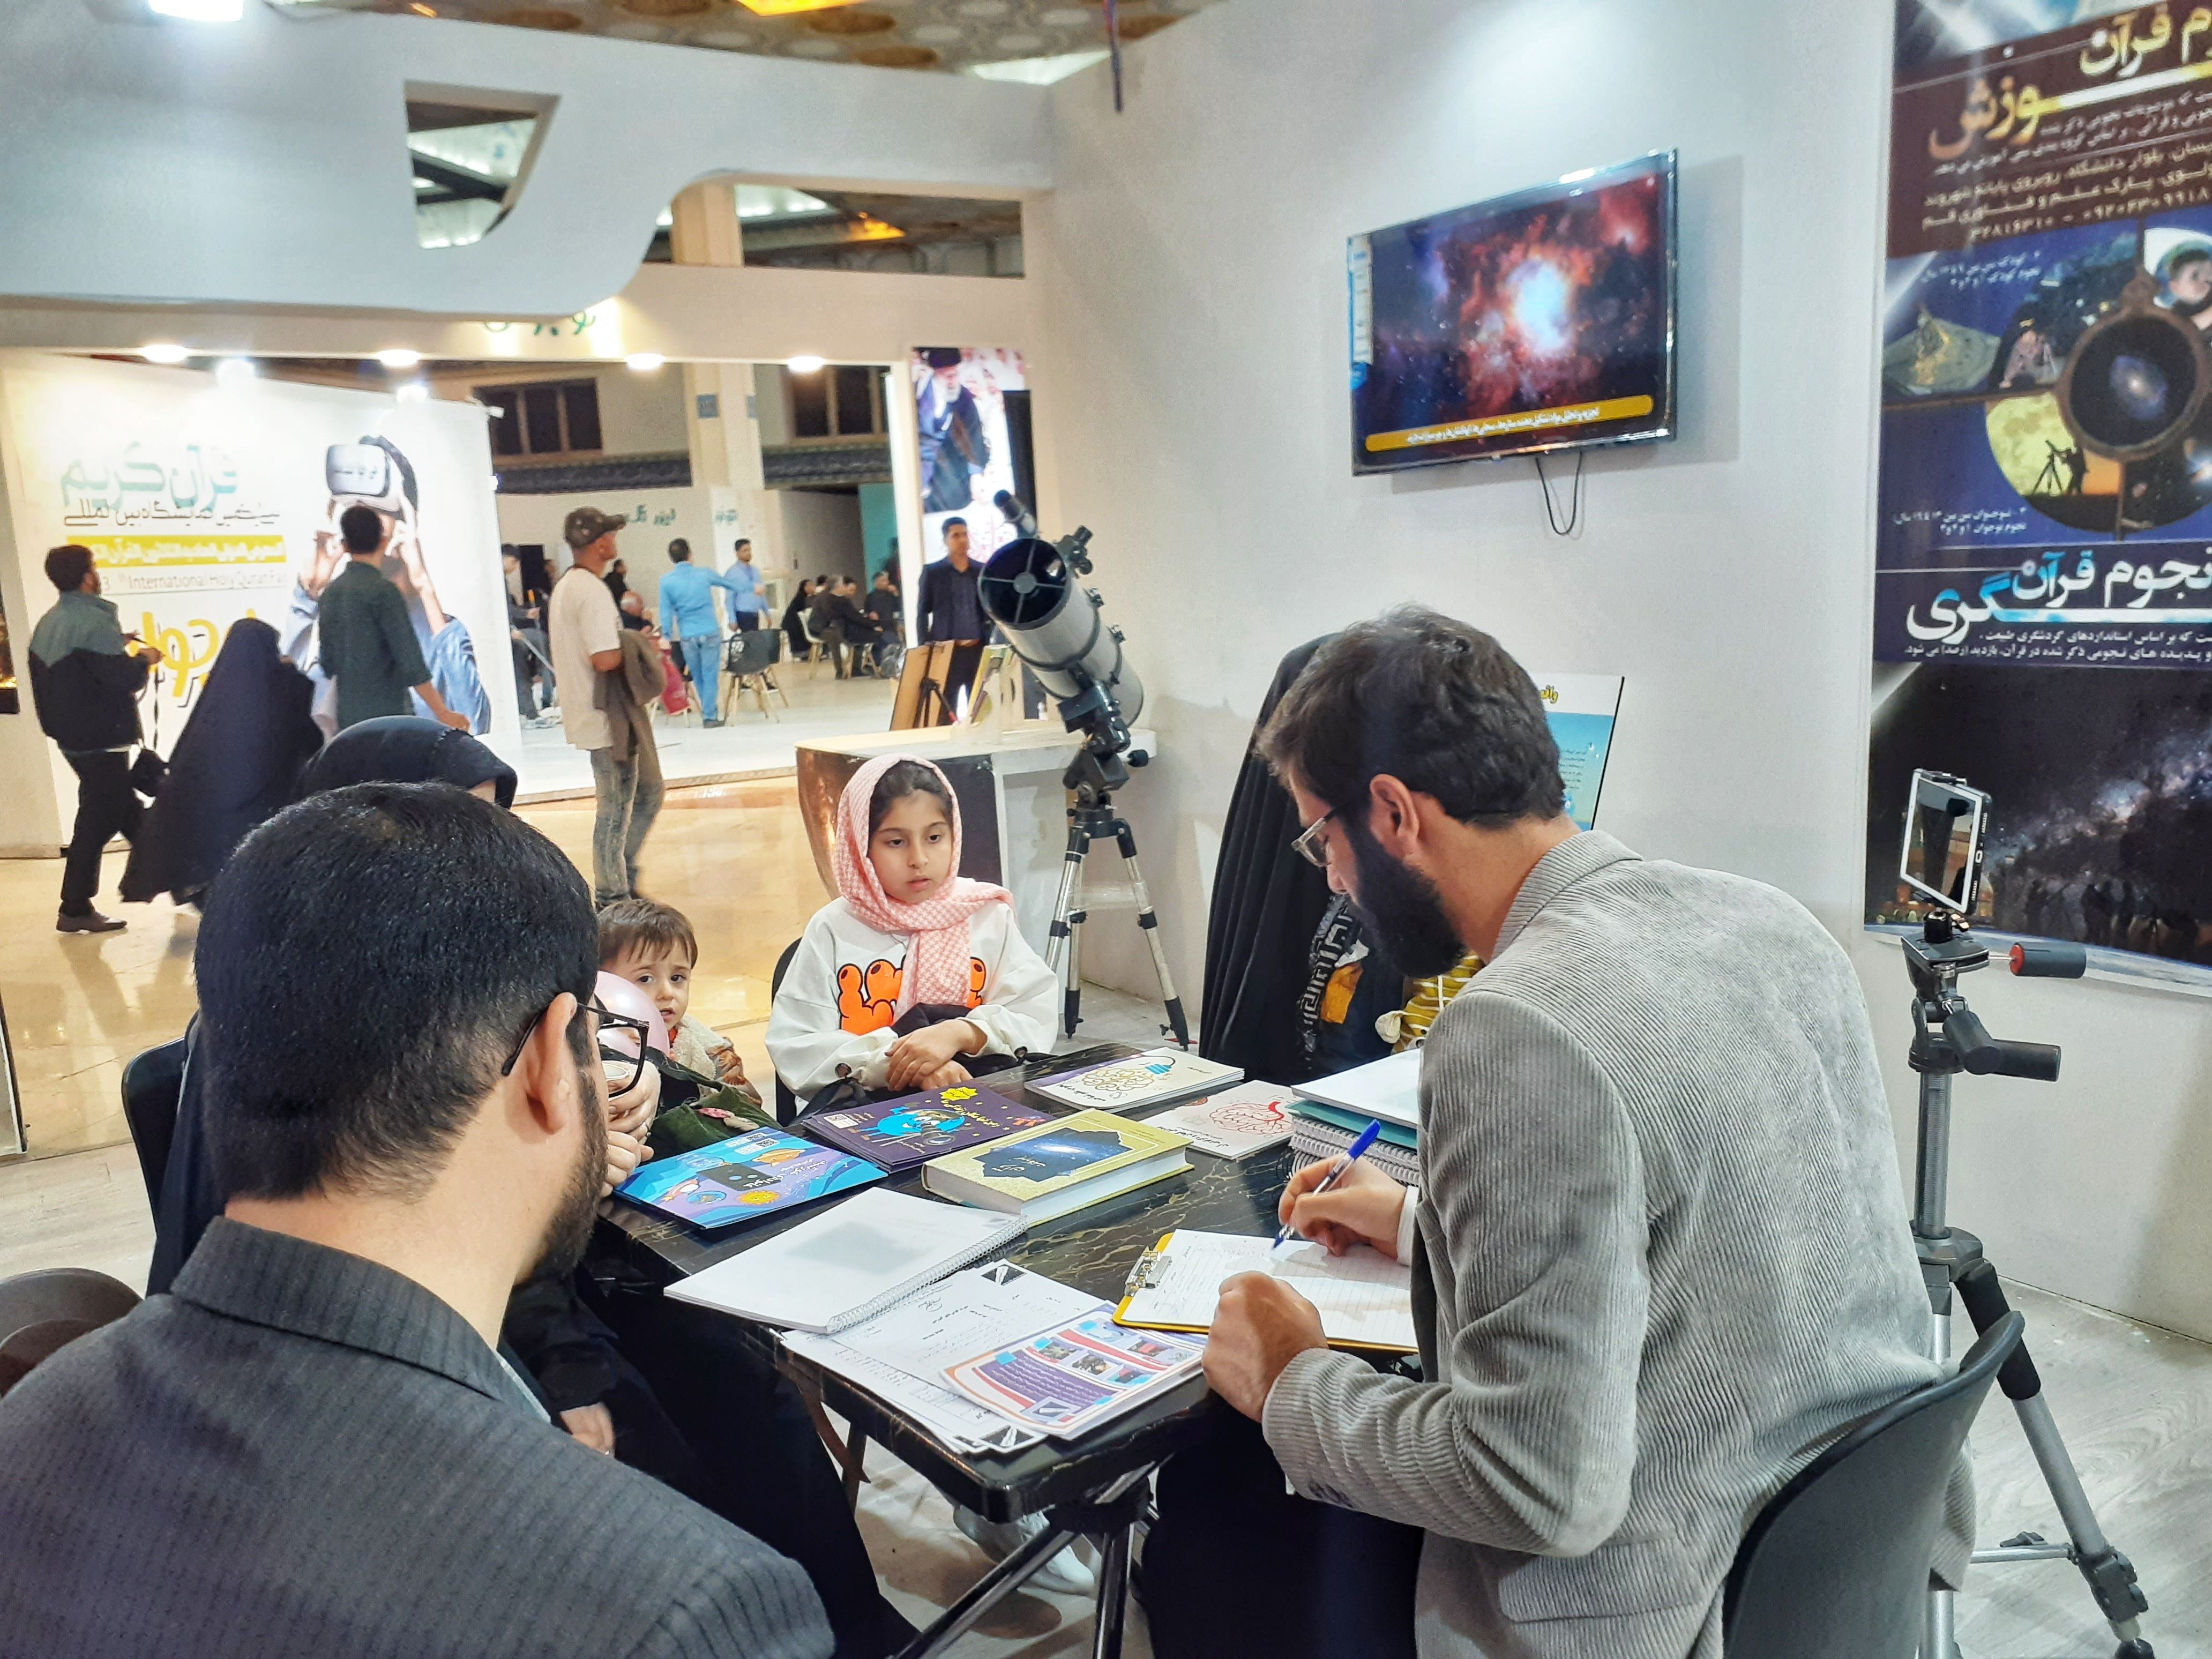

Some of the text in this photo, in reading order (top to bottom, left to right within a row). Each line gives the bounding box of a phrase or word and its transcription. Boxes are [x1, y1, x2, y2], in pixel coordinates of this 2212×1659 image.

[2080, 2, 2173, 78] قرآن
[60, 441, 165, 509] کریم
[2013, 549, 2094, 608] قرآن
[2066, 631, 2133, 644] استانداردهای
[2134, 631, 2165, 645] اساس
[1925, 646, 1940, 658] می
[1969, 645, 1998, 657] بازدید
[2028, 647, 2041, 659] در
[2042, 646, 2063, 656] شده
[2065, 645, 2085, 660] ذکر
[2087, 649, 2127, 661] نجومی
